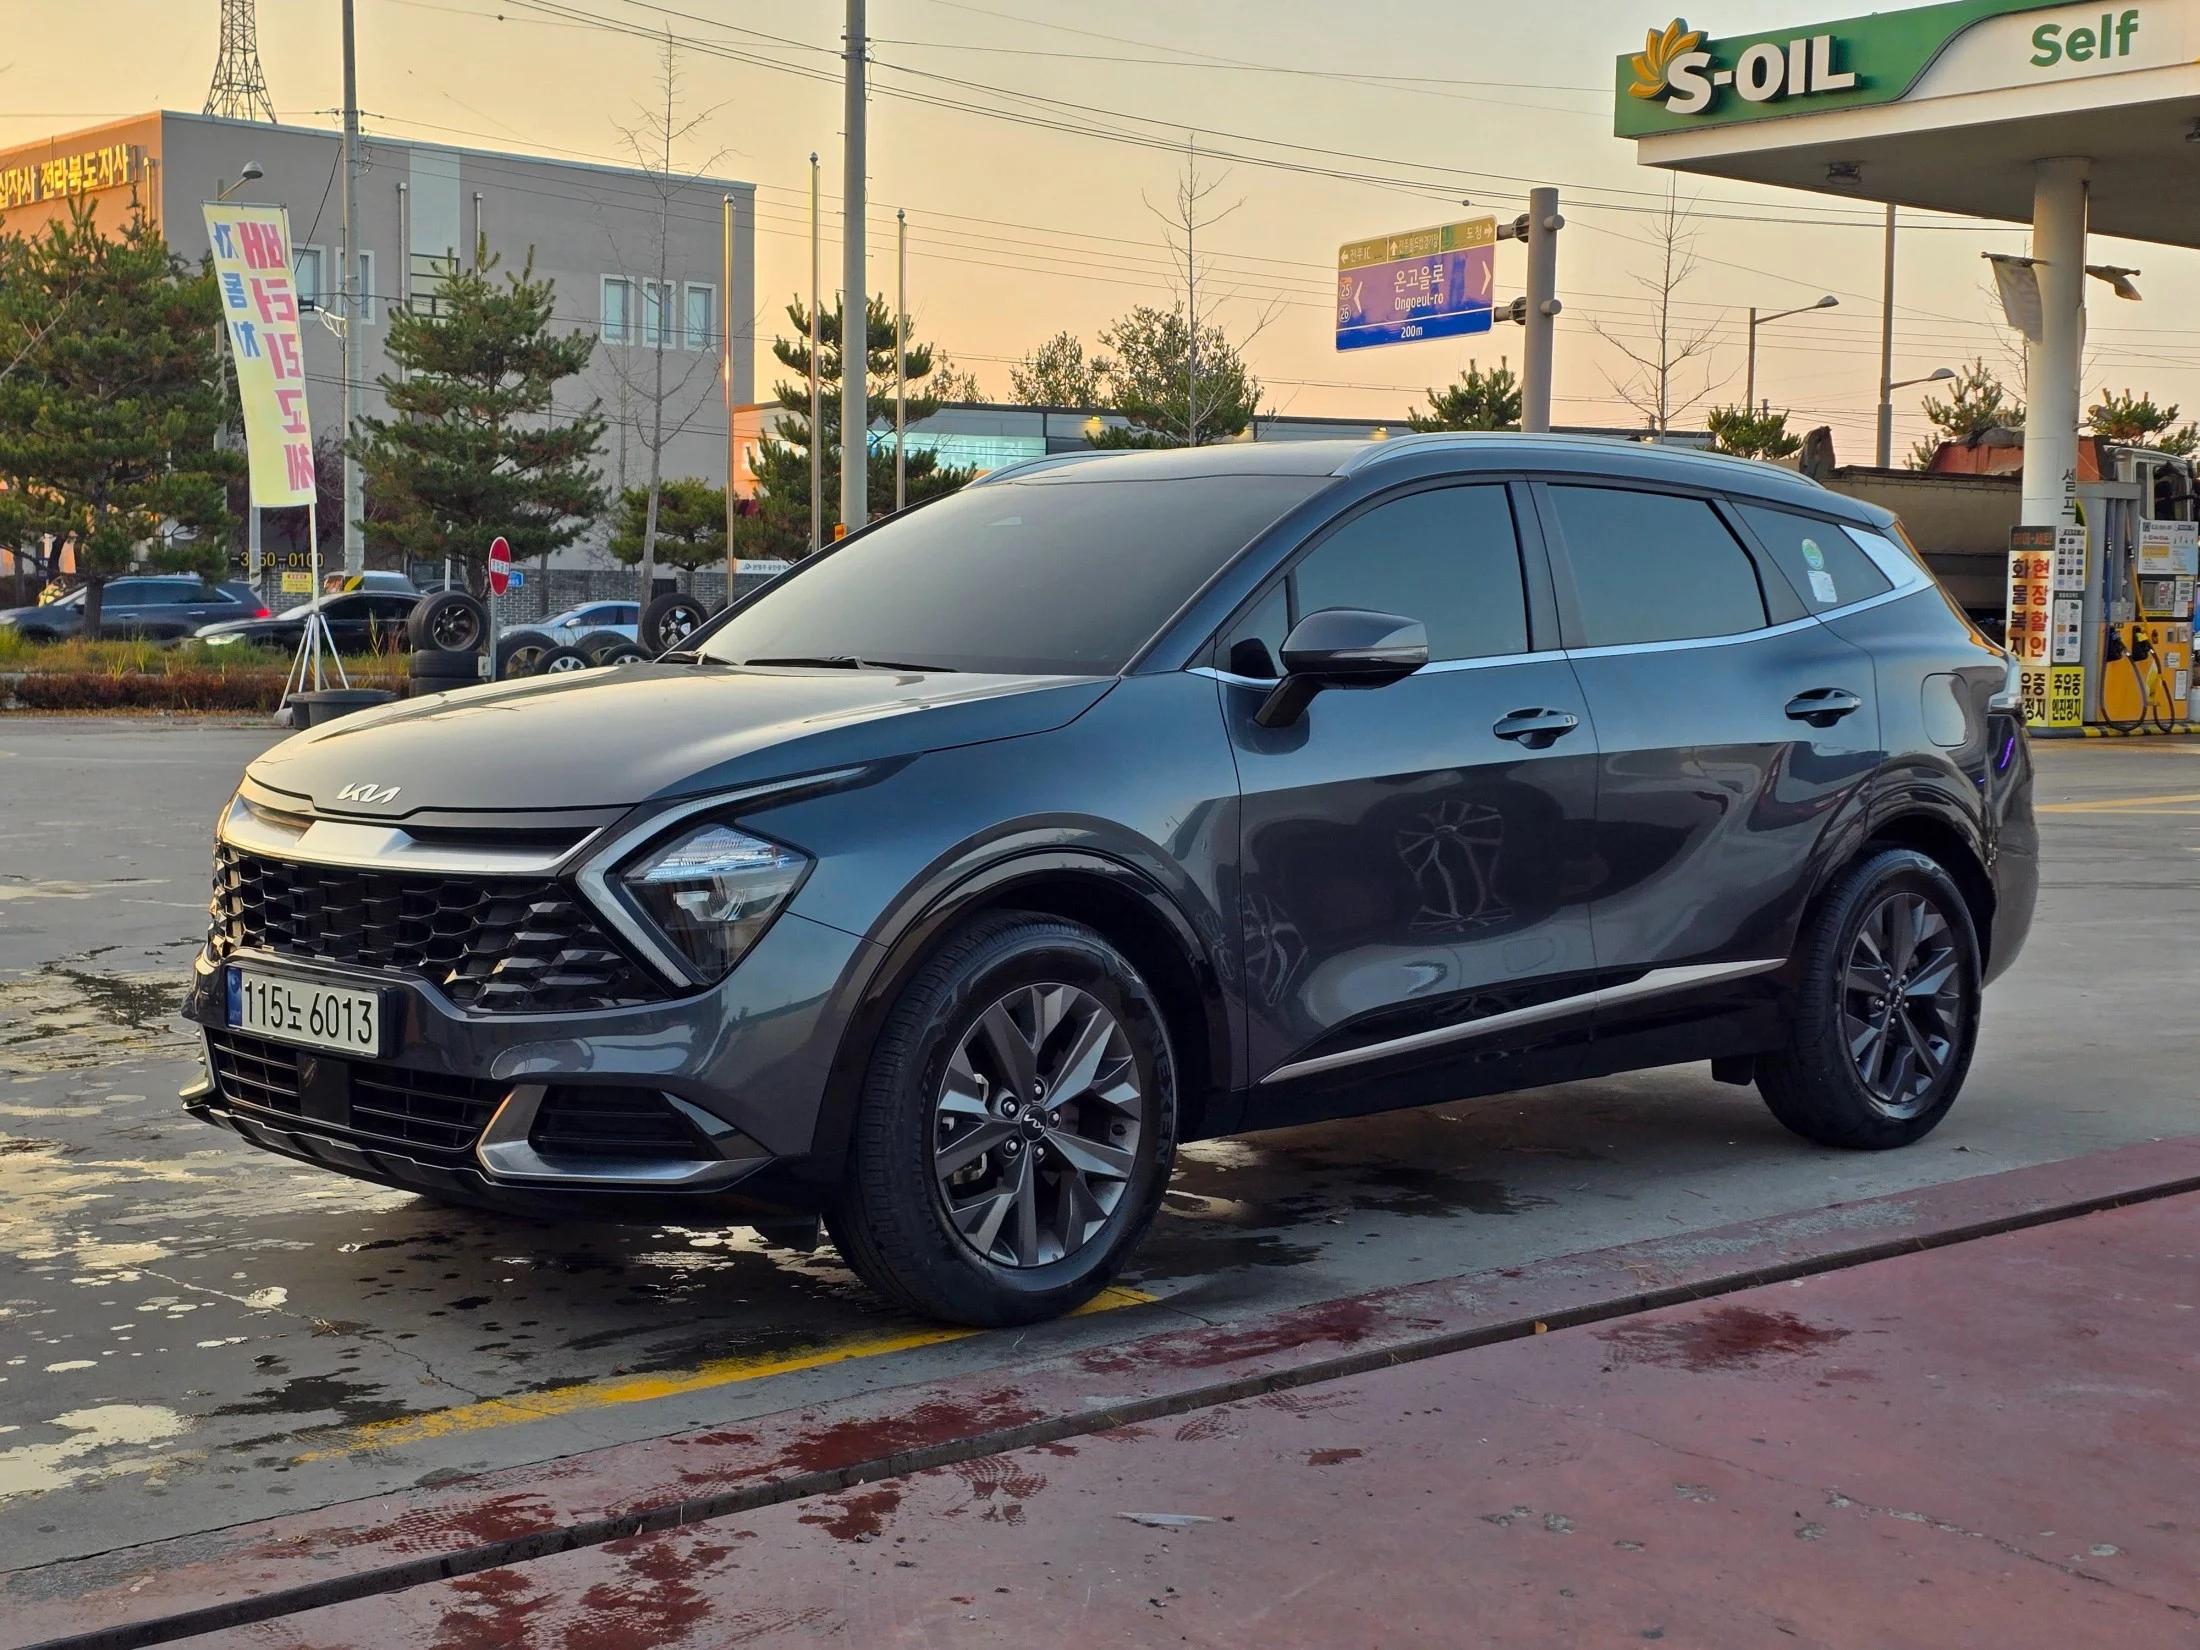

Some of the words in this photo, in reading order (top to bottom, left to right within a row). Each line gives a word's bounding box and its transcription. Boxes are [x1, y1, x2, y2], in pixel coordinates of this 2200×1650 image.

[2030, 9, 2139, 67] Self
[1664, 35, 1856, 114] S-OIL
[41, 143, 128, 199] 전라북도지사
[1466, 226, 1482, 239] 도청
[1394, 264, 1444, 293] 온고을로
[1341, 284, 1350, 297] 25
[1394, 292, 1444, 313] Ongoeul-ro
[1401, 325, 1423, 338] 200m
[2030, 559, 2050, 657] 현장할인
[2021, 673, 2046, 696] 유중
[2054, 673, 2081, 696] 주유중
[2025, 698, 2046, 720] 정지
[2052, 698, 2081, 721] 엔진정지
[244, 979, 302, 1031] 115노
[309, 992, 373, 1044] 6013
